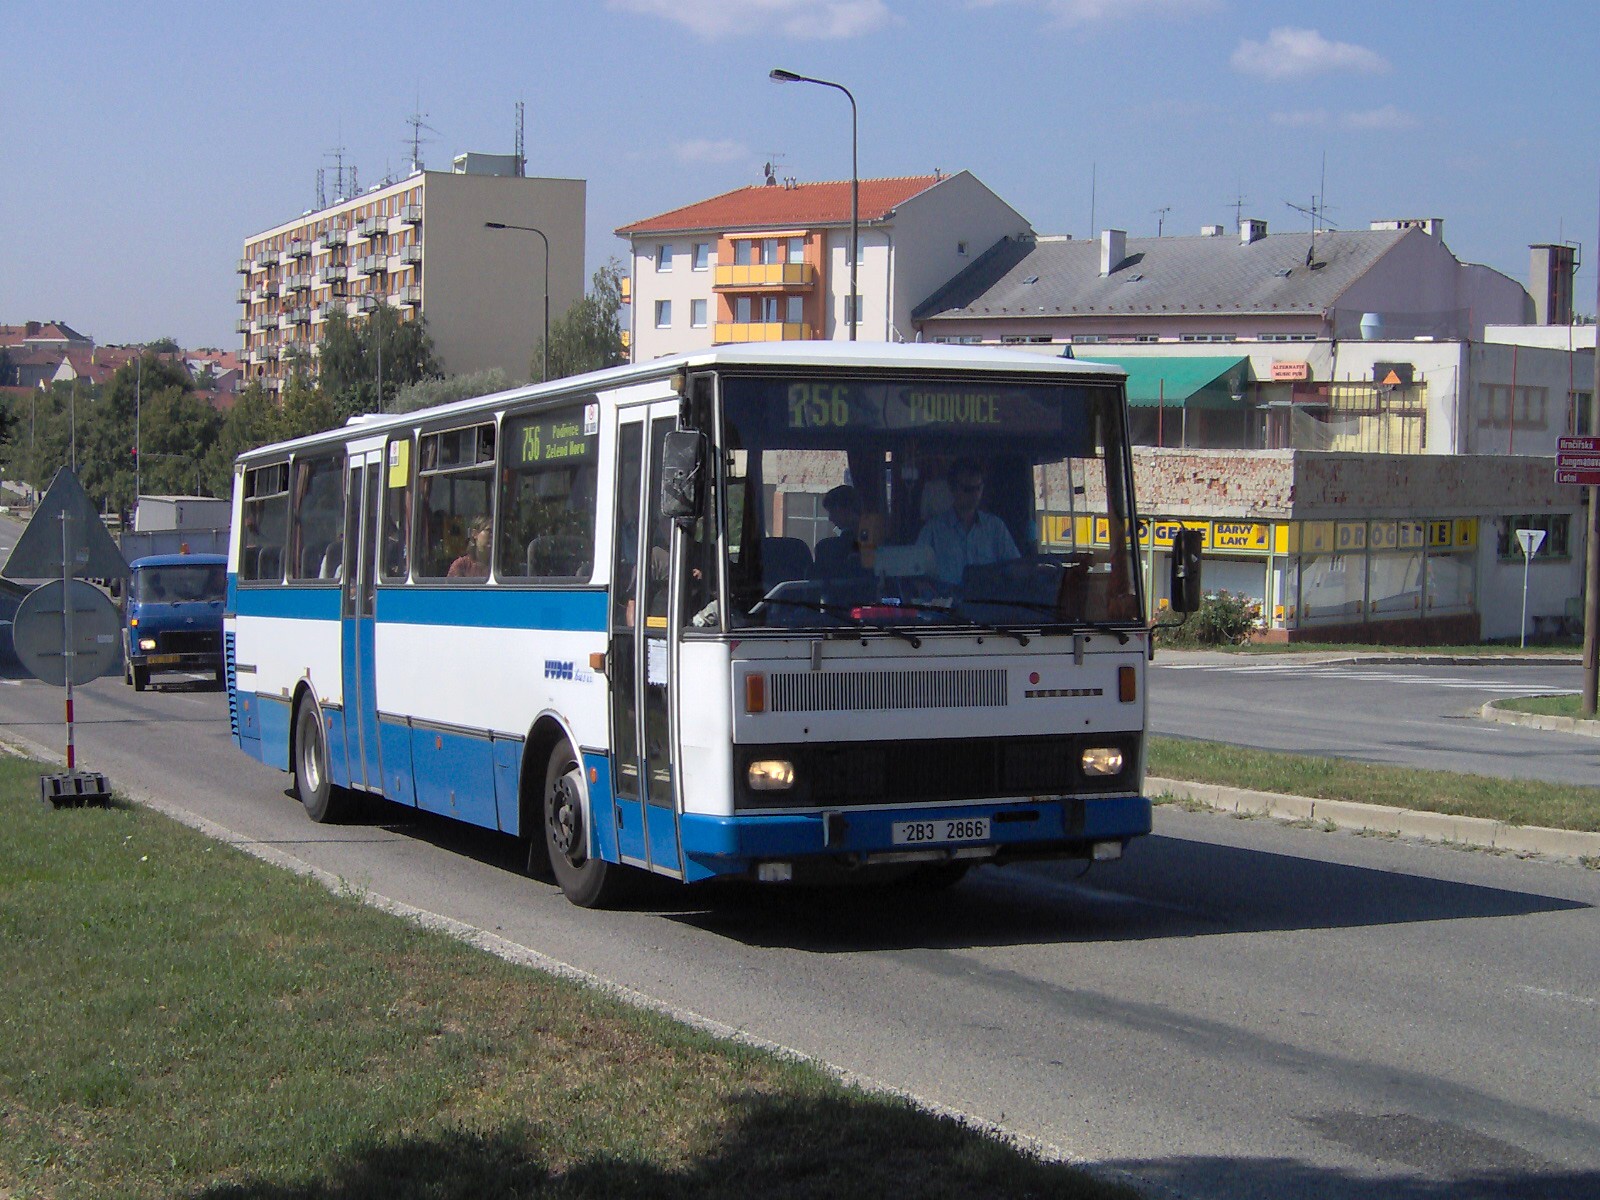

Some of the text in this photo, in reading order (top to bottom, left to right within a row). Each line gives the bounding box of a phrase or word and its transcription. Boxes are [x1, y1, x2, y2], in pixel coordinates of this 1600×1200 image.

[790, 383, 850, 428] 756
[522, 425, 541, 462] 756
[1217, 524, 1253, 536] BARVY
[1220, 536, 1250, 546] LAKY
[1339, 523, 1447, 547] DROGERIE
[906, 820, 983, 841] 2B3 2866
